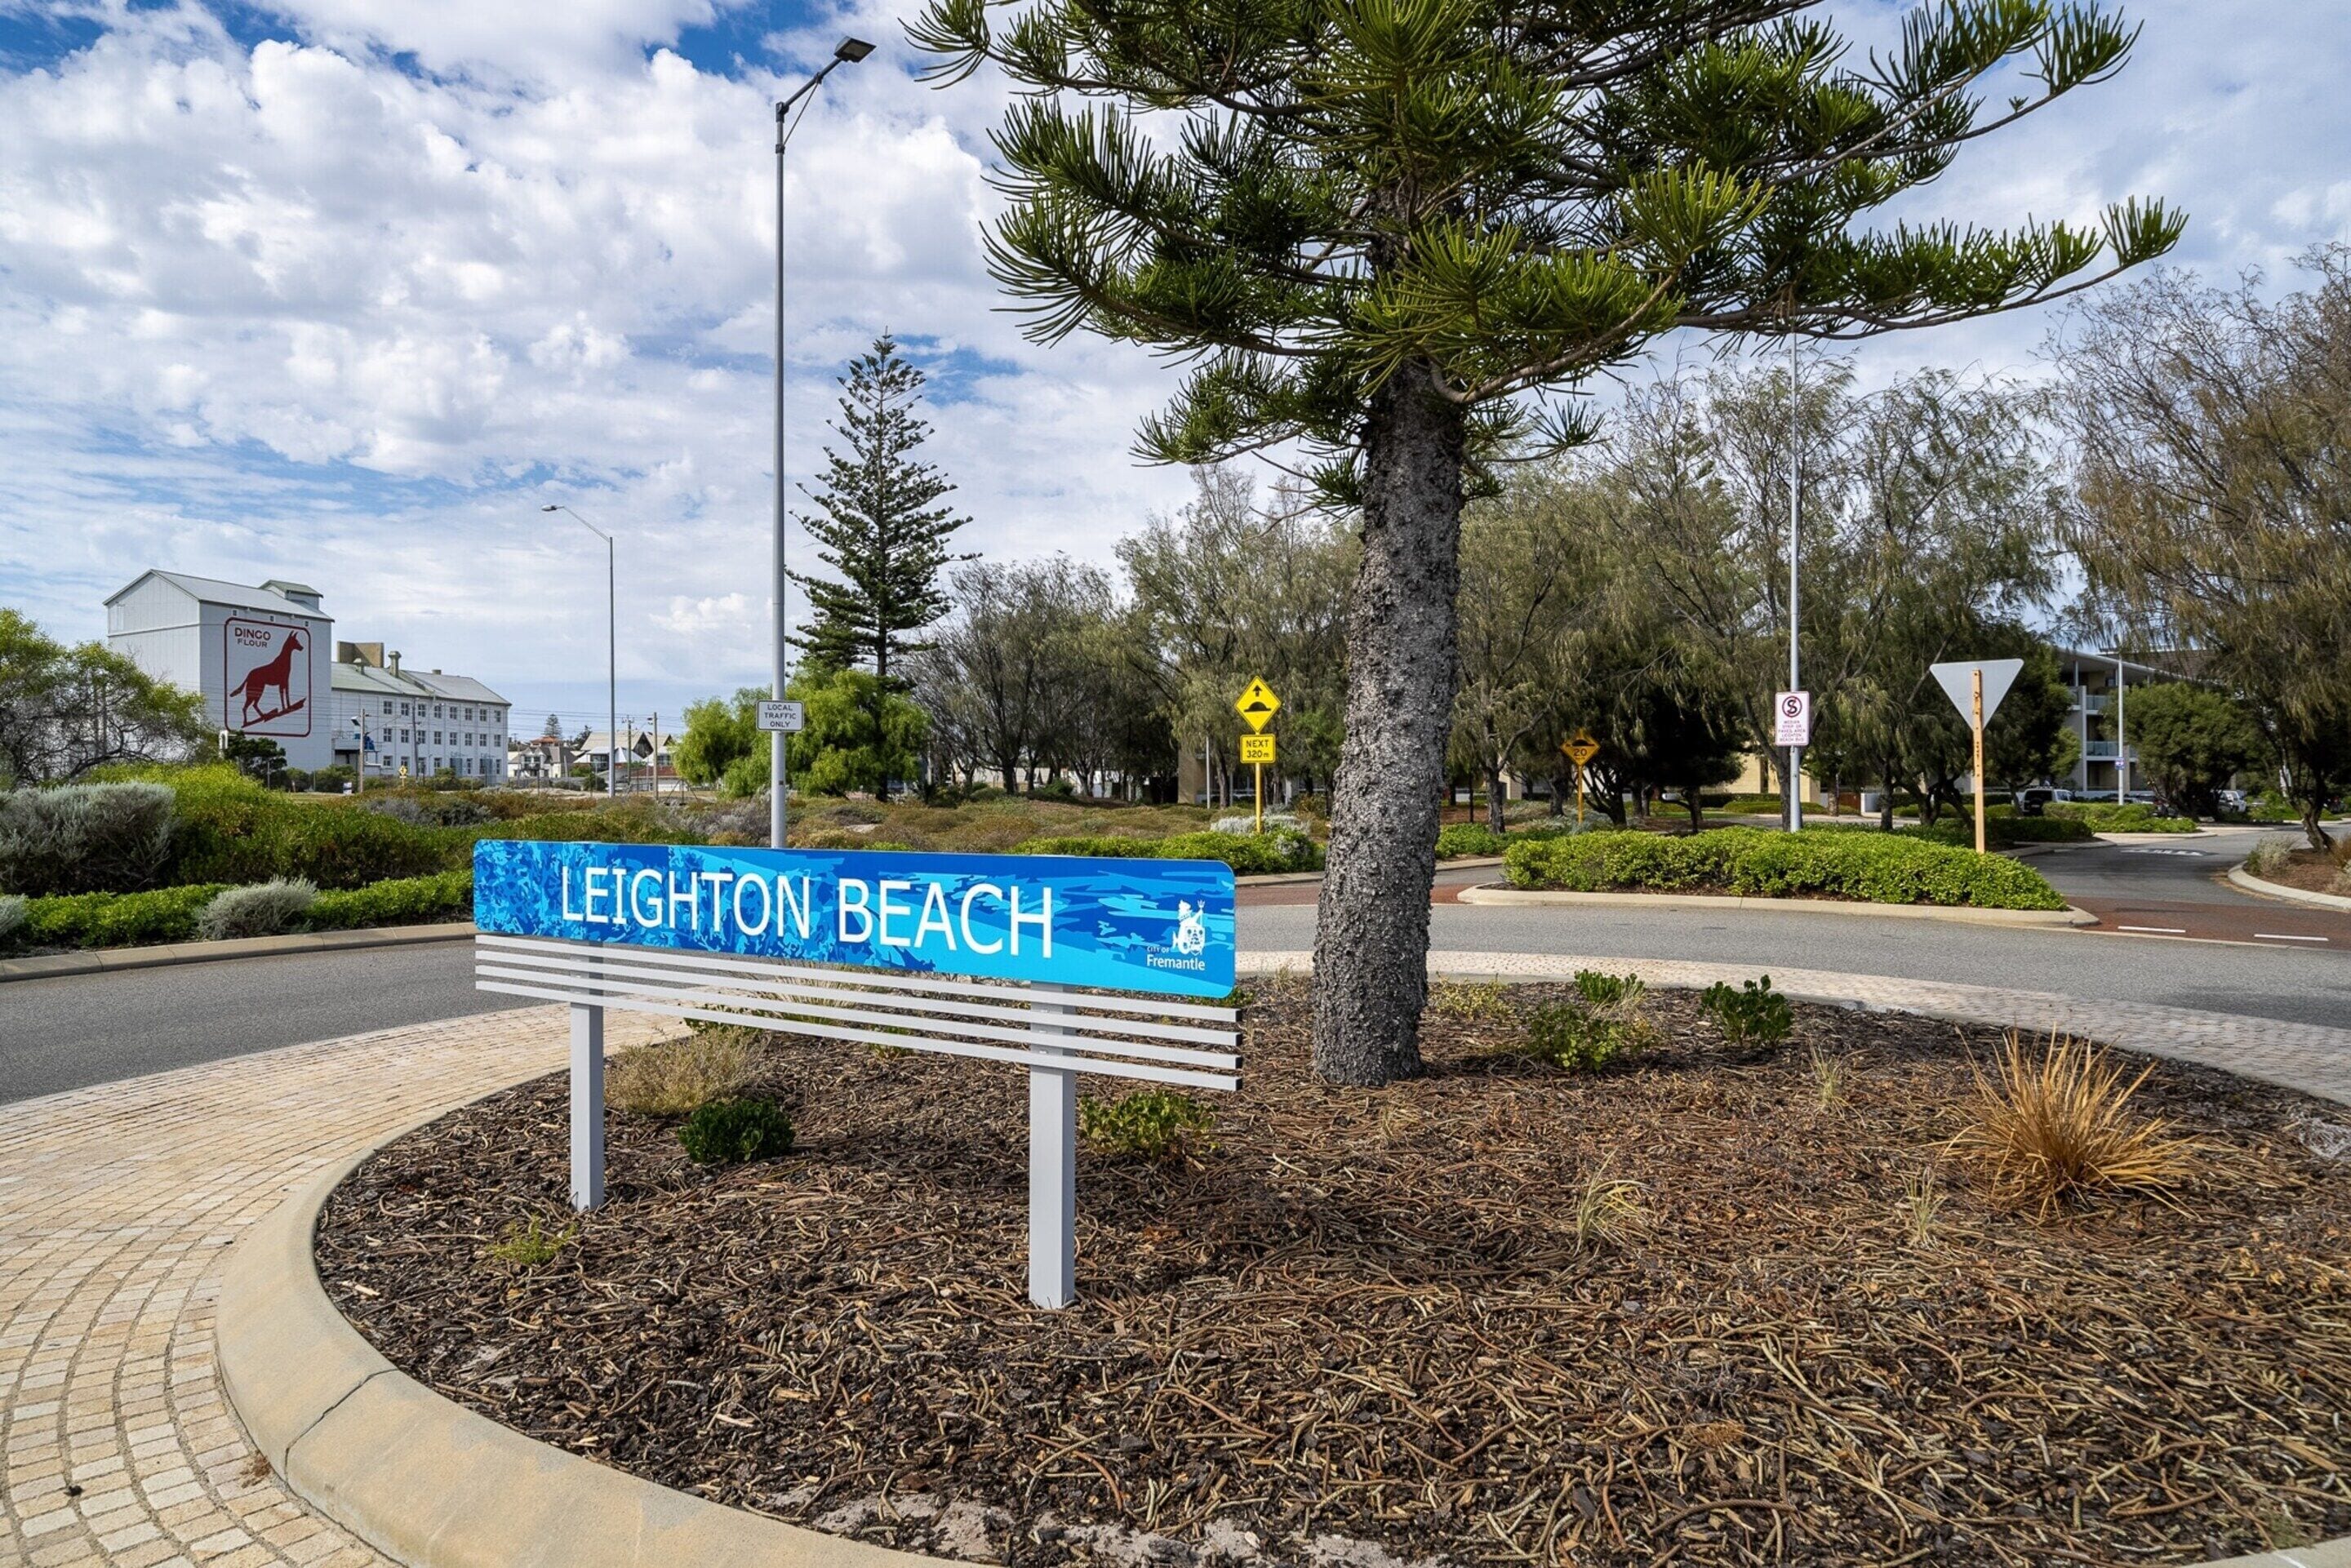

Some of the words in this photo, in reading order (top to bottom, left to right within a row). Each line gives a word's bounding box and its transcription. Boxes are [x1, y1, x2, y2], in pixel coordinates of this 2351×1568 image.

[237, 637, 268, 648] FLOUR
[764, 712, 798, 720] TRAFFIC
[1246, 739, 1269, 748] NEXT
[1574, 748, 1588, 757] 20
[561, 865, 811, 939] LEIGHTON
[838, 877, 1052, 959] BEACH
[1146, 953, 1206, 971] Fremantle
